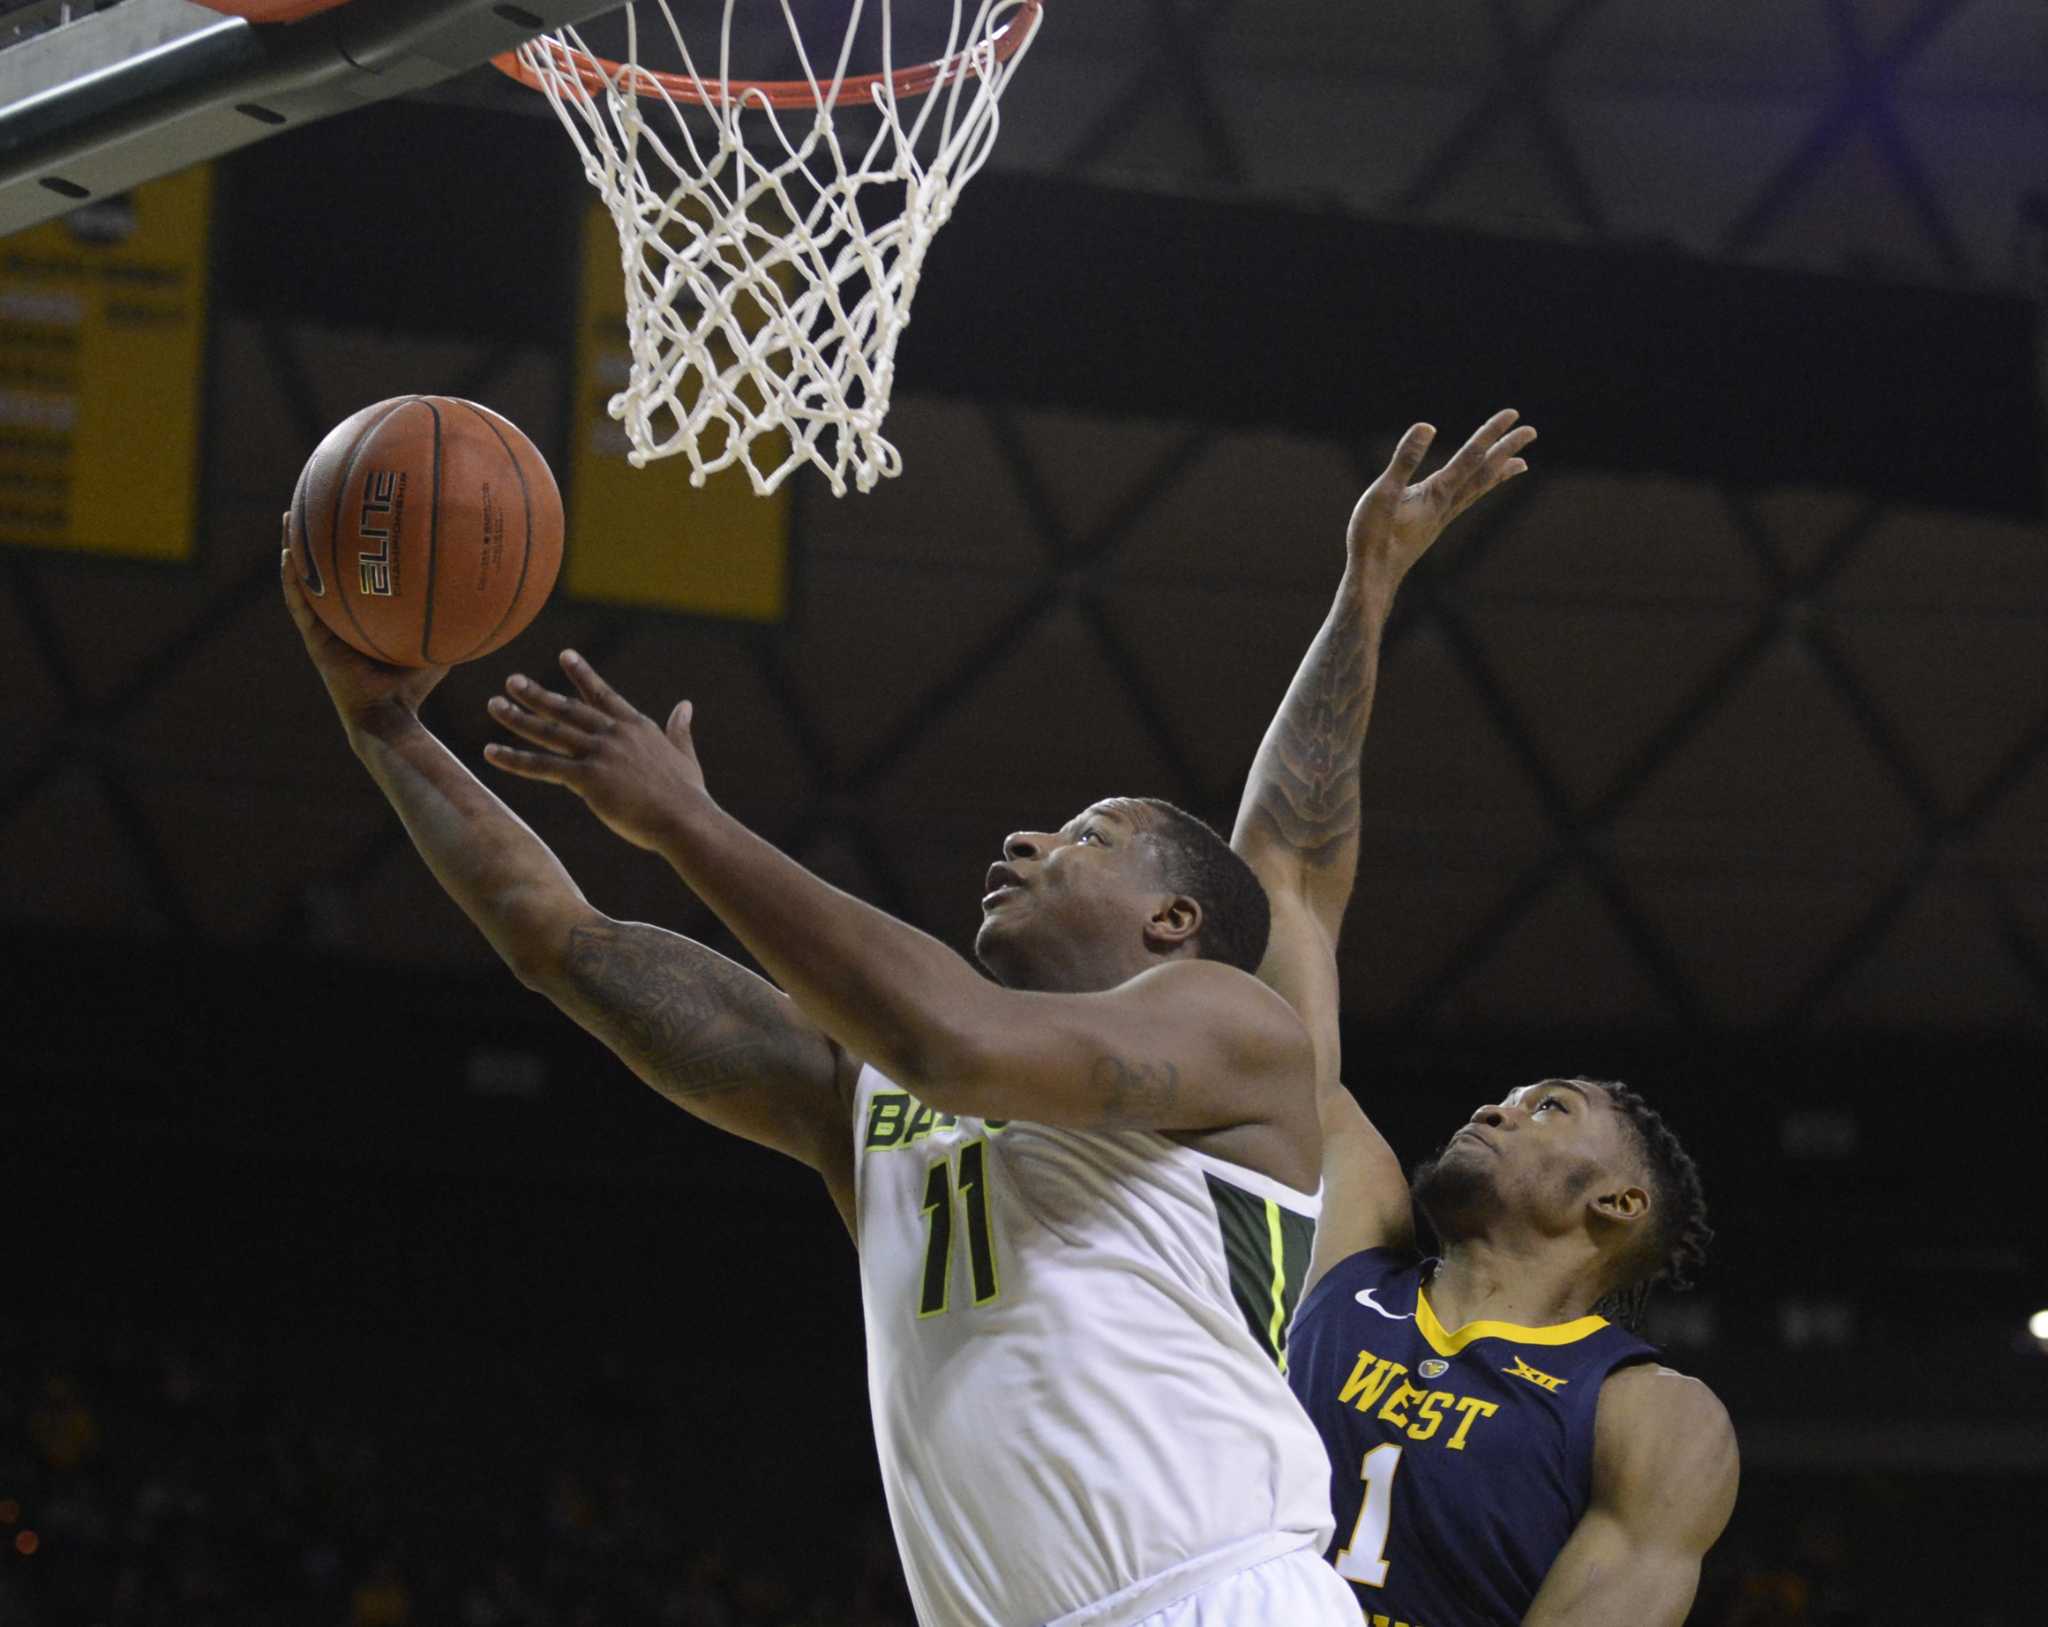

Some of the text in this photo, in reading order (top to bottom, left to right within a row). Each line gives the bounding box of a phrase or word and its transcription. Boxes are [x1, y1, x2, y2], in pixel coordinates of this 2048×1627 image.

[358, 472, 397, 596] ELITE
[918, 1137, 999, 1319] 11
[1336, 1349, 1501, 1451] WEST
[1335, 1441, 1403, 1589] 1
